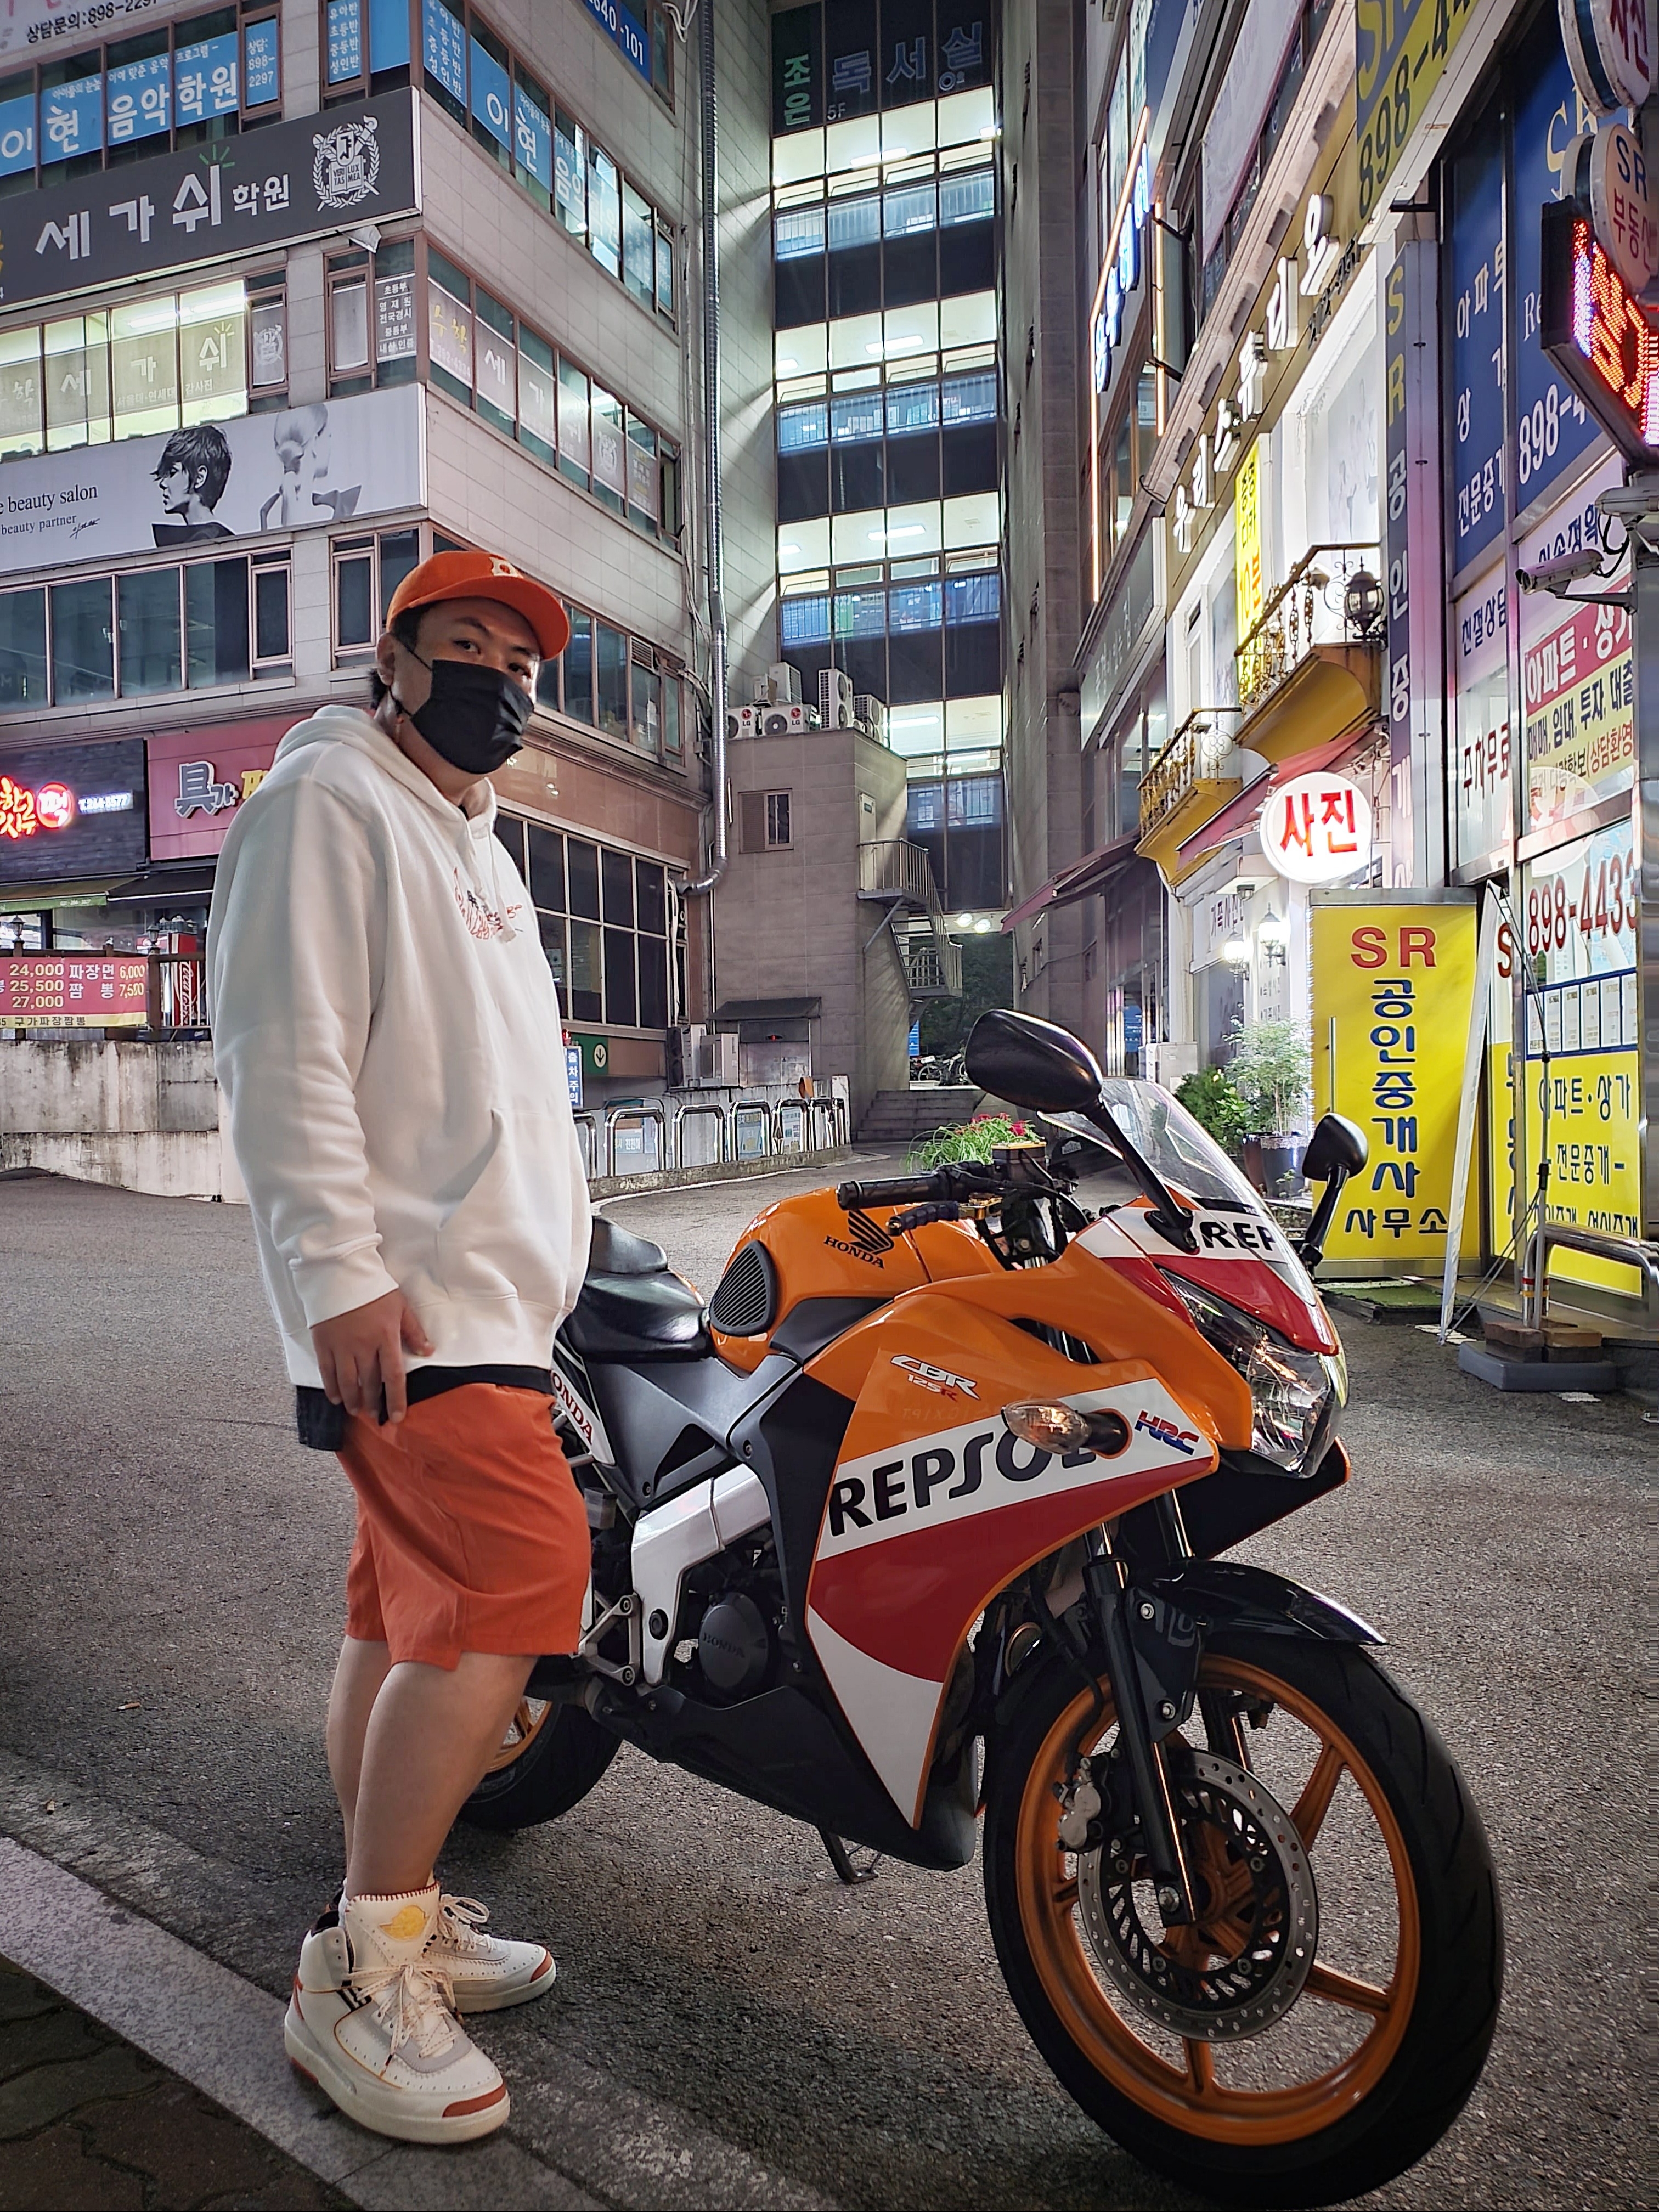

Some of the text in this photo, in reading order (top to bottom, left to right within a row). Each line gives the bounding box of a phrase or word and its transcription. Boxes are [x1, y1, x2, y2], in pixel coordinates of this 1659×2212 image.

[329, 2, 358, 20] 유아반
[329, 19, 358, 37] 초등반
[330, 37, 358, 57] 중등반
[832, 21, 983, 93] 독서실
[248, 55, 275, 70] 898-
[331, 54, 359, 74] 성인반
[249, 71, 274, 88] 2297
[429, 55, 461, 98] 성인반
[827, 103, 845, 120] 5F
[347, 165, 359, 174] LUX
[348, 173, 360, 182] MEA
[1616, 134, 1647, 202] SR
[334, 177, 345, 185] TAS
[233, 174, 290, 216] 학원
[383, 281, 407, 295] 초등부
[379, 308, 411, 324] 전국경시
[385, 323, 408, 337] 중등부
[8, 494, 55, 512] beauty
[60, 484, 98, 504] salon
[1, 522, 35, 535] beauty
[39, 515, 77, 532] partner
[1279, 789, 1358, 857] 사진
[1351, 927, 1437, 969] SR
[9, 963, 64, 978] 24,000
[69, 964, 145, 980] 짜장면 6,000
[9, 979, 64, 994] 25,500
[12, 995, 64, 1009] 27,000
[15, 1016, 86, 1026] 구가짜장짬뽕
[567, 1051, 579, 1104] 출차주의
[1370, 979, 1421, 1199] 공인중개사
[1345, 1207, 1448, 1239] 사무소
[823, 1234, 885, 1269] HONDA
[890, 1353, 981, 1401] CBR
[907, 1374, 959, 1402] 125R
[551, 1373, 594, 1445] ONDA
[1134, 1410, 1201, 1456] HRC
[830, 1432, 1097, 1537] REPSO
[701, 1631, 746, 1660] HONDA
